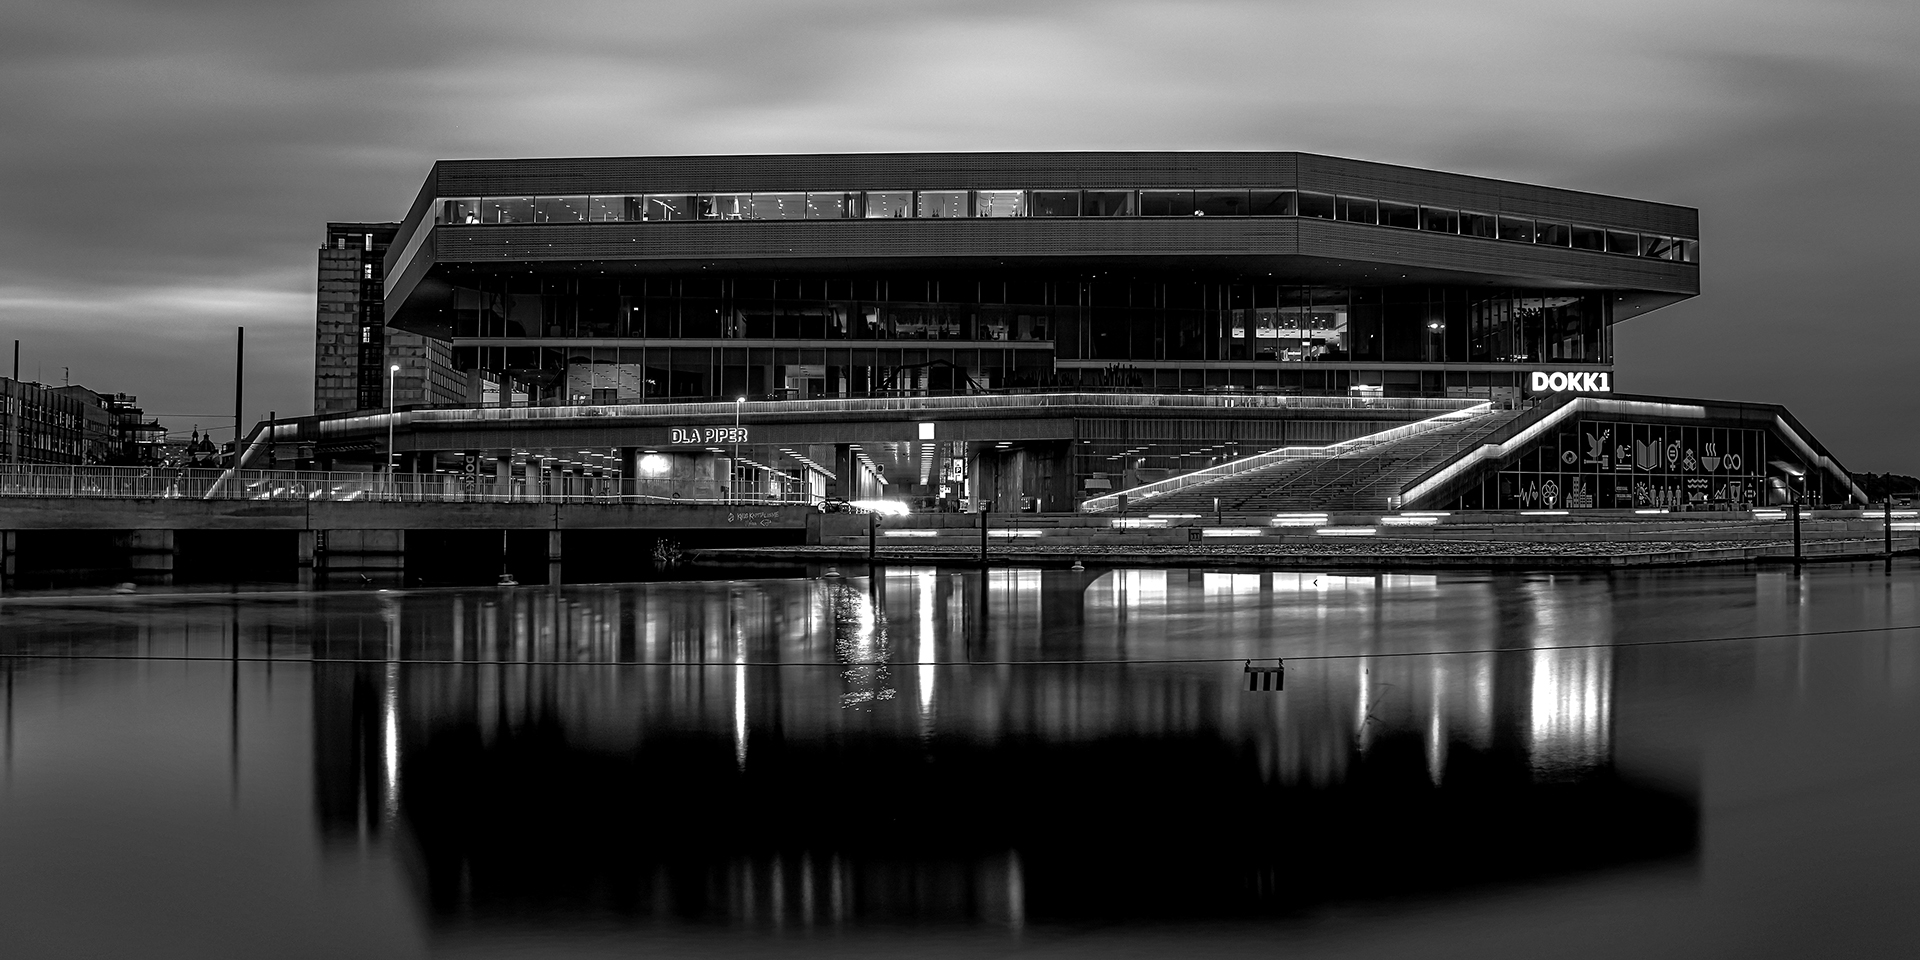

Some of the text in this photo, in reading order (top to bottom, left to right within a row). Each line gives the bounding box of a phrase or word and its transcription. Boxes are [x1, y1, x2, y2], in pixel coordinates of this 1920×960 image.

[1532, 371, 1610, 392] DOKK1
[672, 427, 748, 443] DLA PIPER
